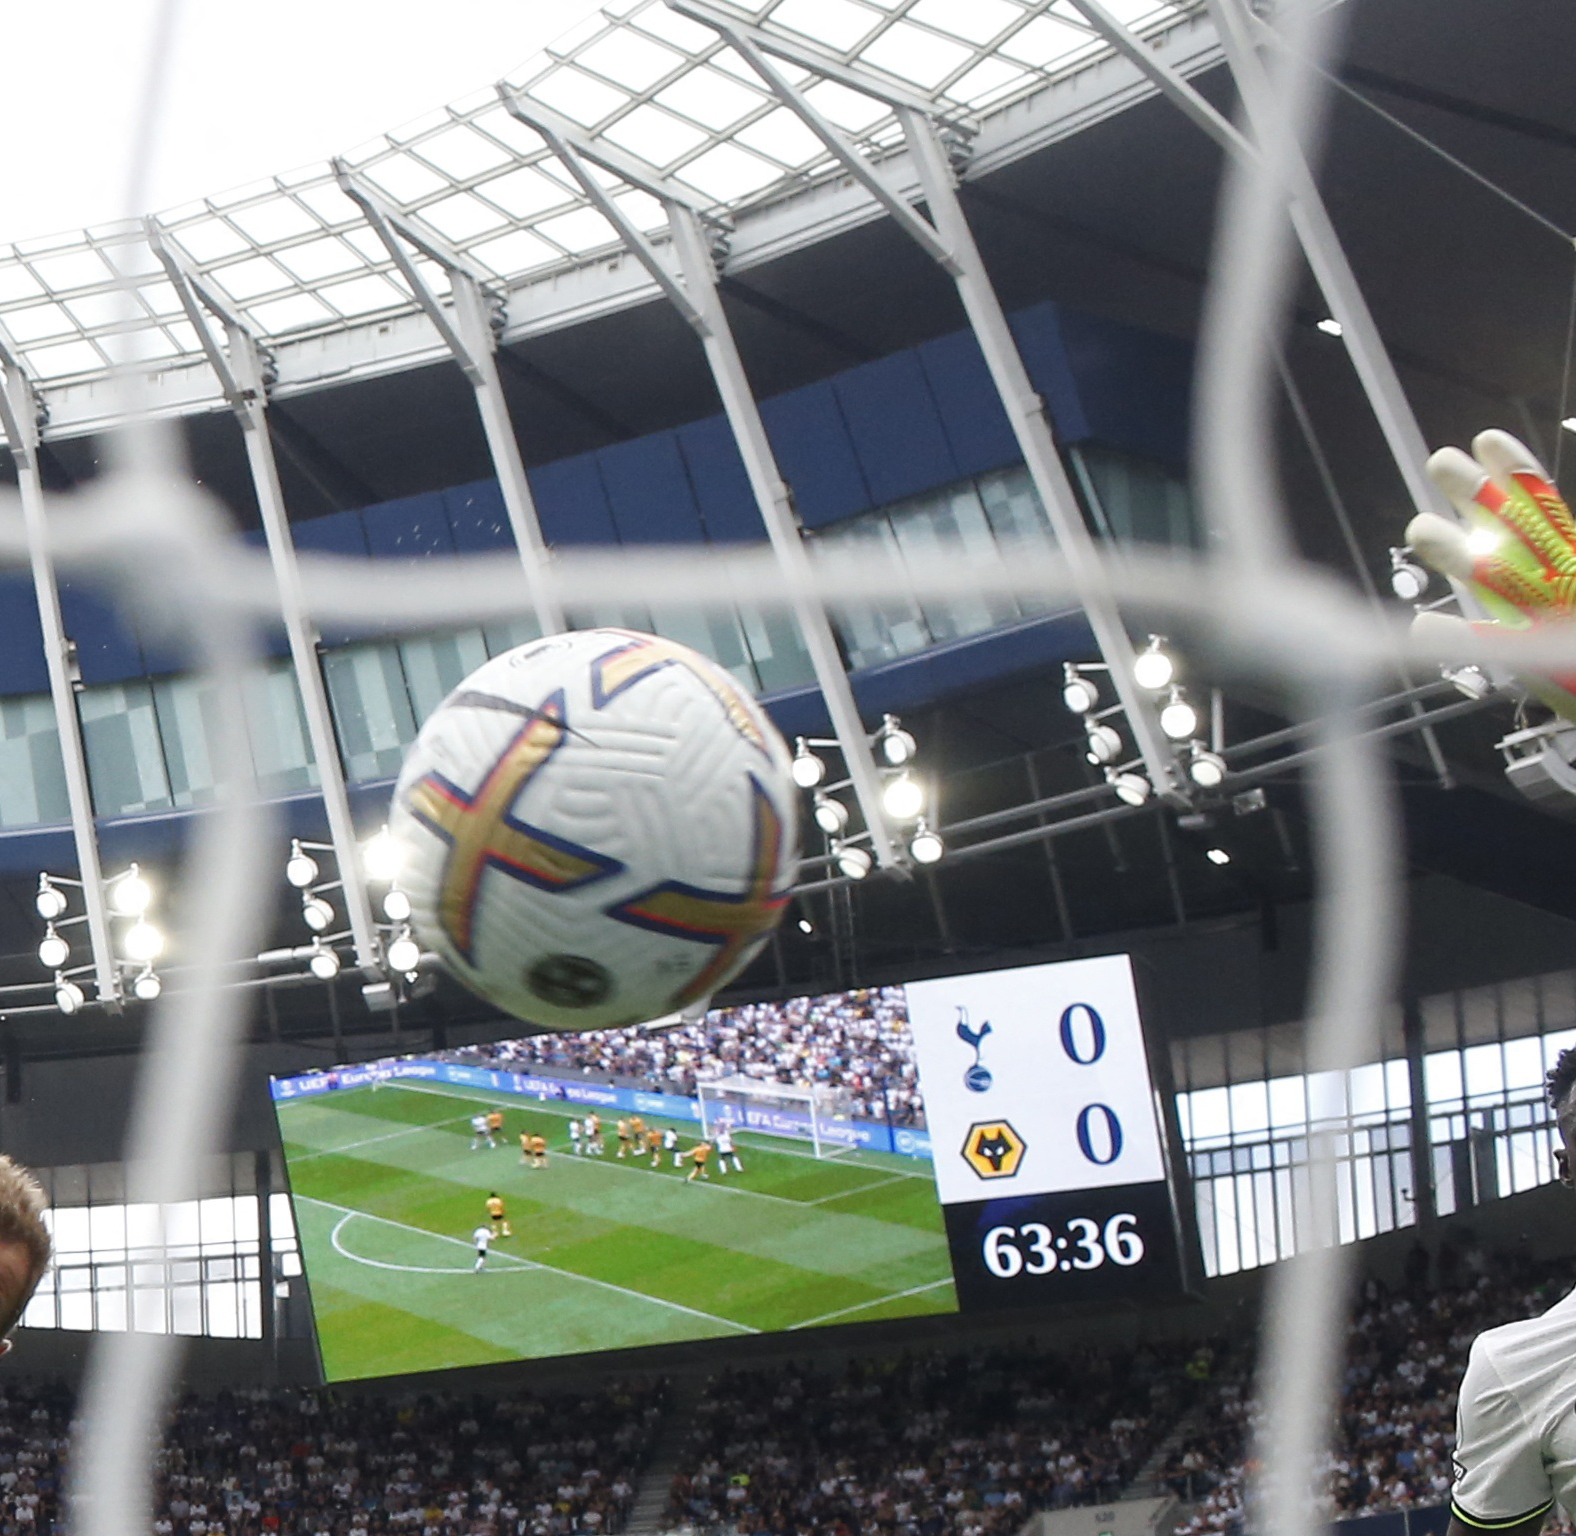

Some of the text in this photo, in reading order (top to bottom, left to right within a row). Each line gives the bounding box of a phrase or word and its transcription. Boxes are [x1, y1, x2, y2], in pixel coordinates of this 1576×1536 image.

[1059, 1003, 1106, 1065] 0
[1076, 1103, 1123, 1165] 0
[982, 1213, 1145, 1278] 63:36
